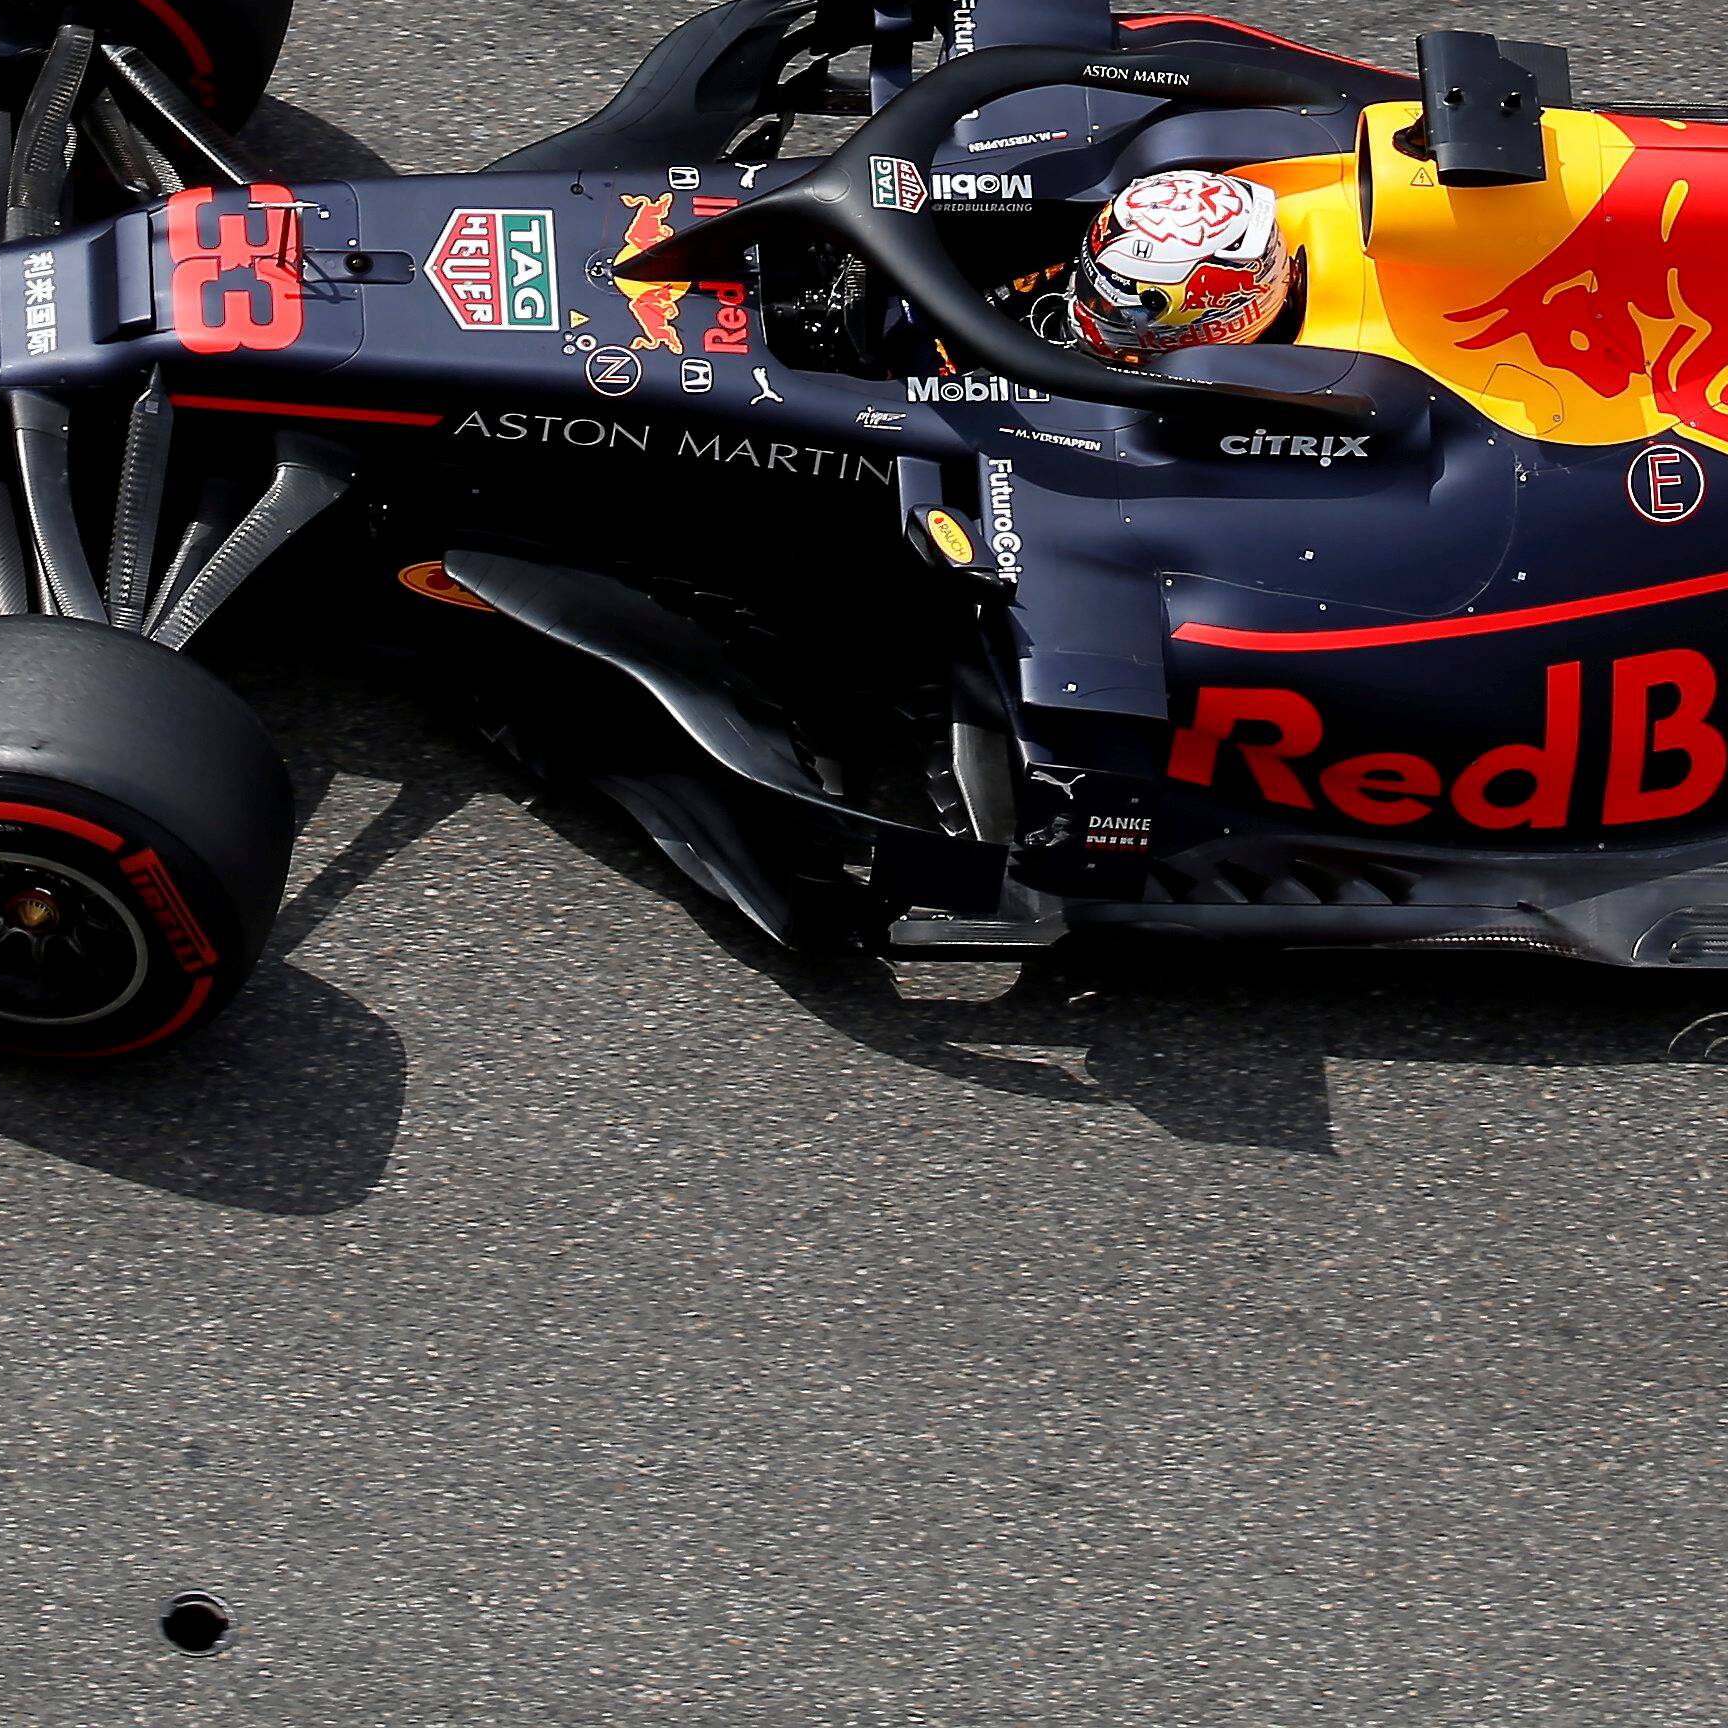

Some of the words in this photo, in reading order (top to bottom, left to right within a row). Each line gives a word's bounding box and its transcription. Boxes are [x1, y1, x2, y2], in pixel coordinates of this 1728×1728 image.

[1083, 65, 1129, 80] ASTON
[1133, 71, 1190, 86] MARTIN
[876, 159, 893, 204] TAG
[899, 162, 922, 209] HEUER
[931, 173, 1033, 200] Mobil
[167, 183, 304, 354] 33
[441, 216, 494, 323] HEUER
[510, 219, 546, 320] TAG
[23, 250, 58, 357] 利来国际
[1202, 299, 1262, 342] Bull
[907, 375, 1010, 402] Mobil
[453, 410, 650, 452] ASTON
[677, 430, 894, 486] MARTIN
[1648, 453, 1683, 514] E
[939, 523, 969, 557] RAUCH
[1167, 661, 1581, 831] Red
[1088, 816, 1152, 831] DANKE
